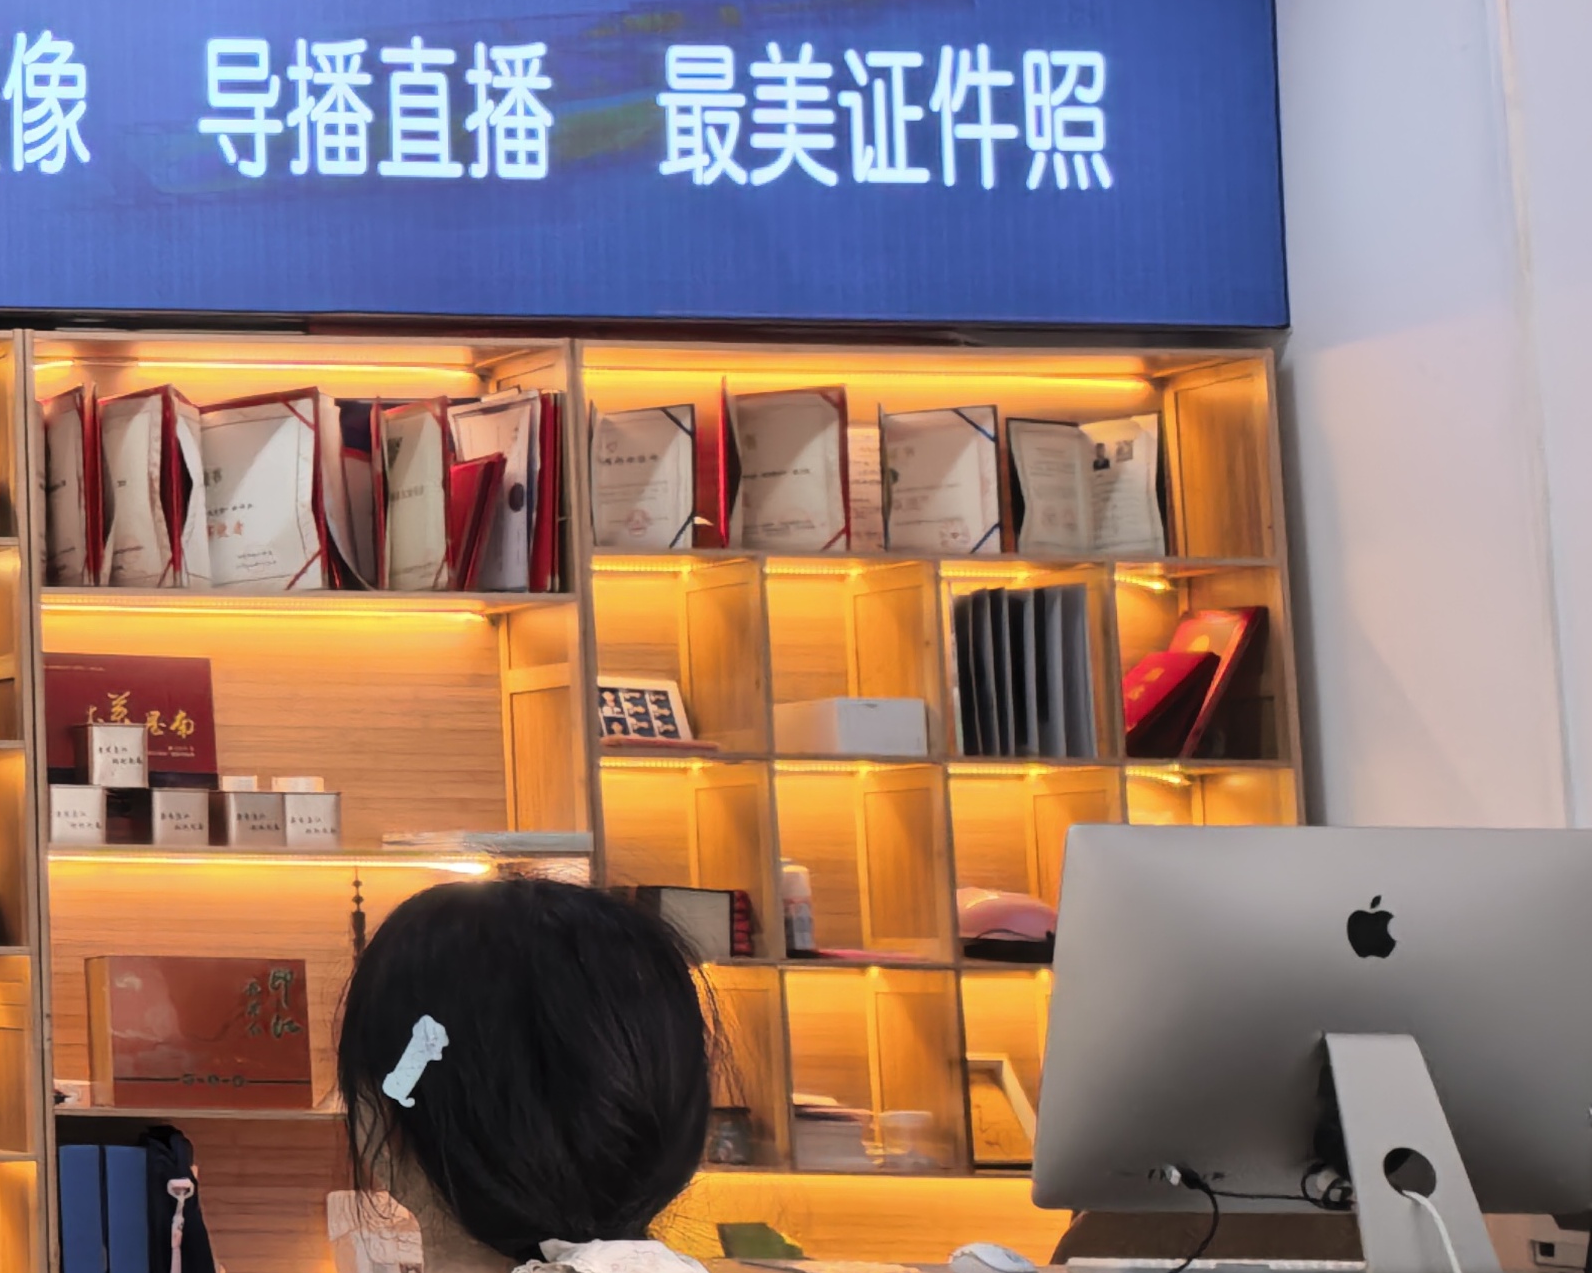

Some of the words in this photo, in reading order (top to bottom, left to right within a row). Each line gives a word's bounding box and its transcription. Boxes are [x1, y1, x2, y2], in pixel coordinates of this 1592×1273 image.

[197, 35, 555, 180] 导播直播
[657, 42, 1113, 191] 最美证件照
